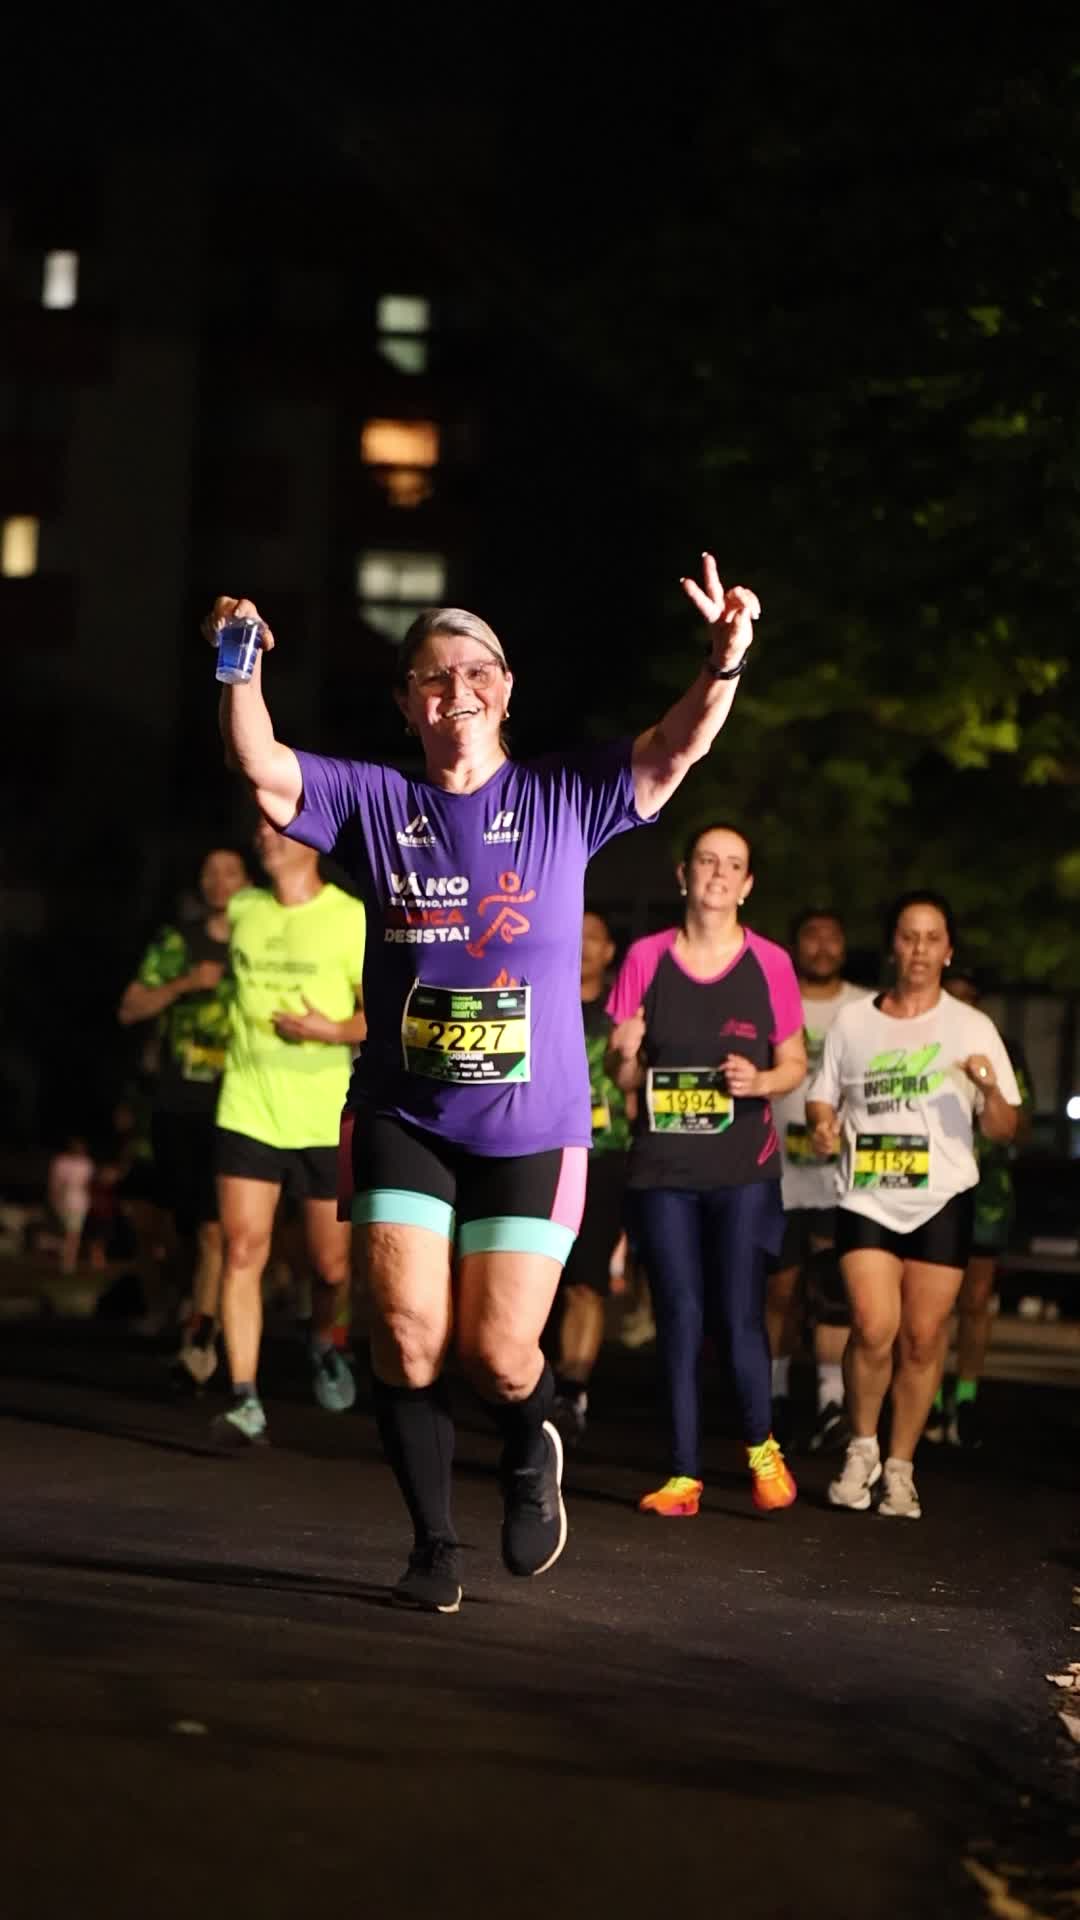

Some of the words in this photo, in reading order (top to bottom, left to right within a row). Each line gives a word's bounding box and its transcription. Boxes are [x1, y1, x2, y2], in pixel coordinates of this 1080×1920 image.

[425, 875, 470, 897] NO
[442, 898, 468, 909] MAS
[383, 925, 470, 944] DESISTA!
[427, 1022, 507, 1051] 2227
[863, 1074, 929, 1099] INSPIRA
[666, 1091, 716, 1112] 1994
[866, 1152, 916, 1174] 1152
